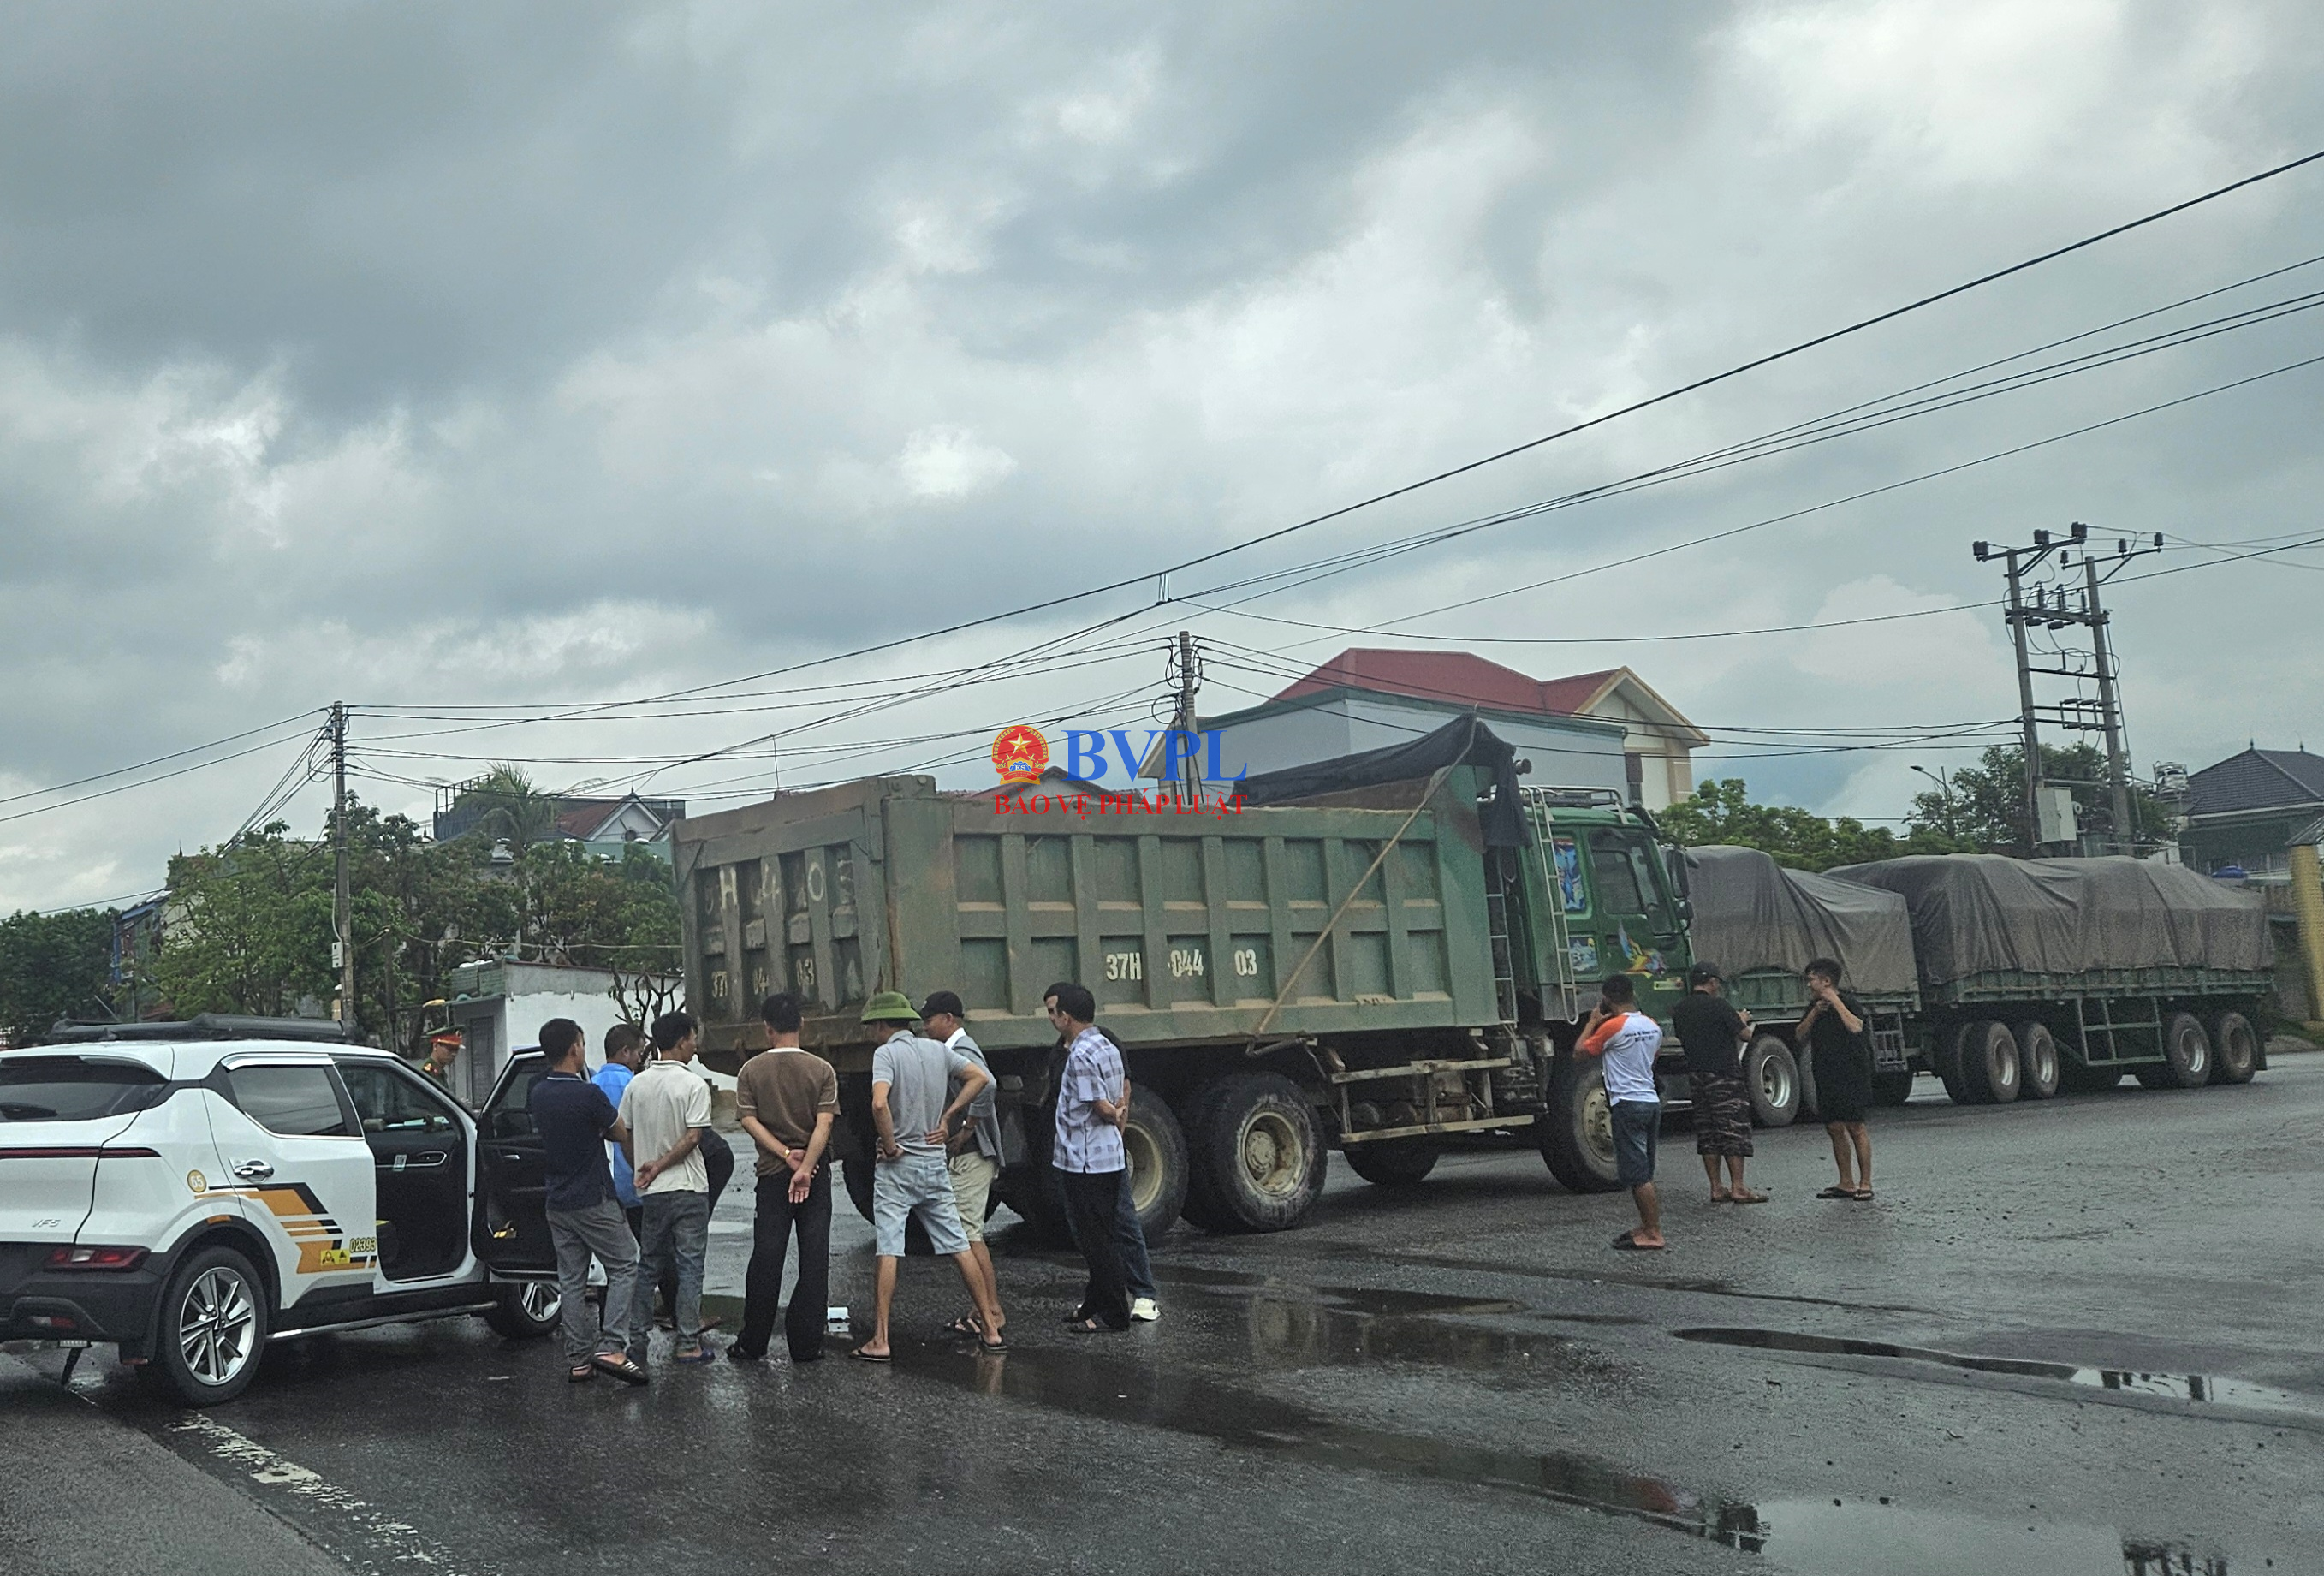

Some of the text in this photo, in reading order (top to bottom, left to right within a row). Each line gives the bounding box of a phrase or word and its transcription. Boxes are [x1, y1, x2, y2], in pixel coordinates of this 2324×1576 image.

[1106, 949, 1257, 980] 37H 044 03
[190, 1175, 204, 1188] 65
[349, 1237, 377, 1253] 02393
